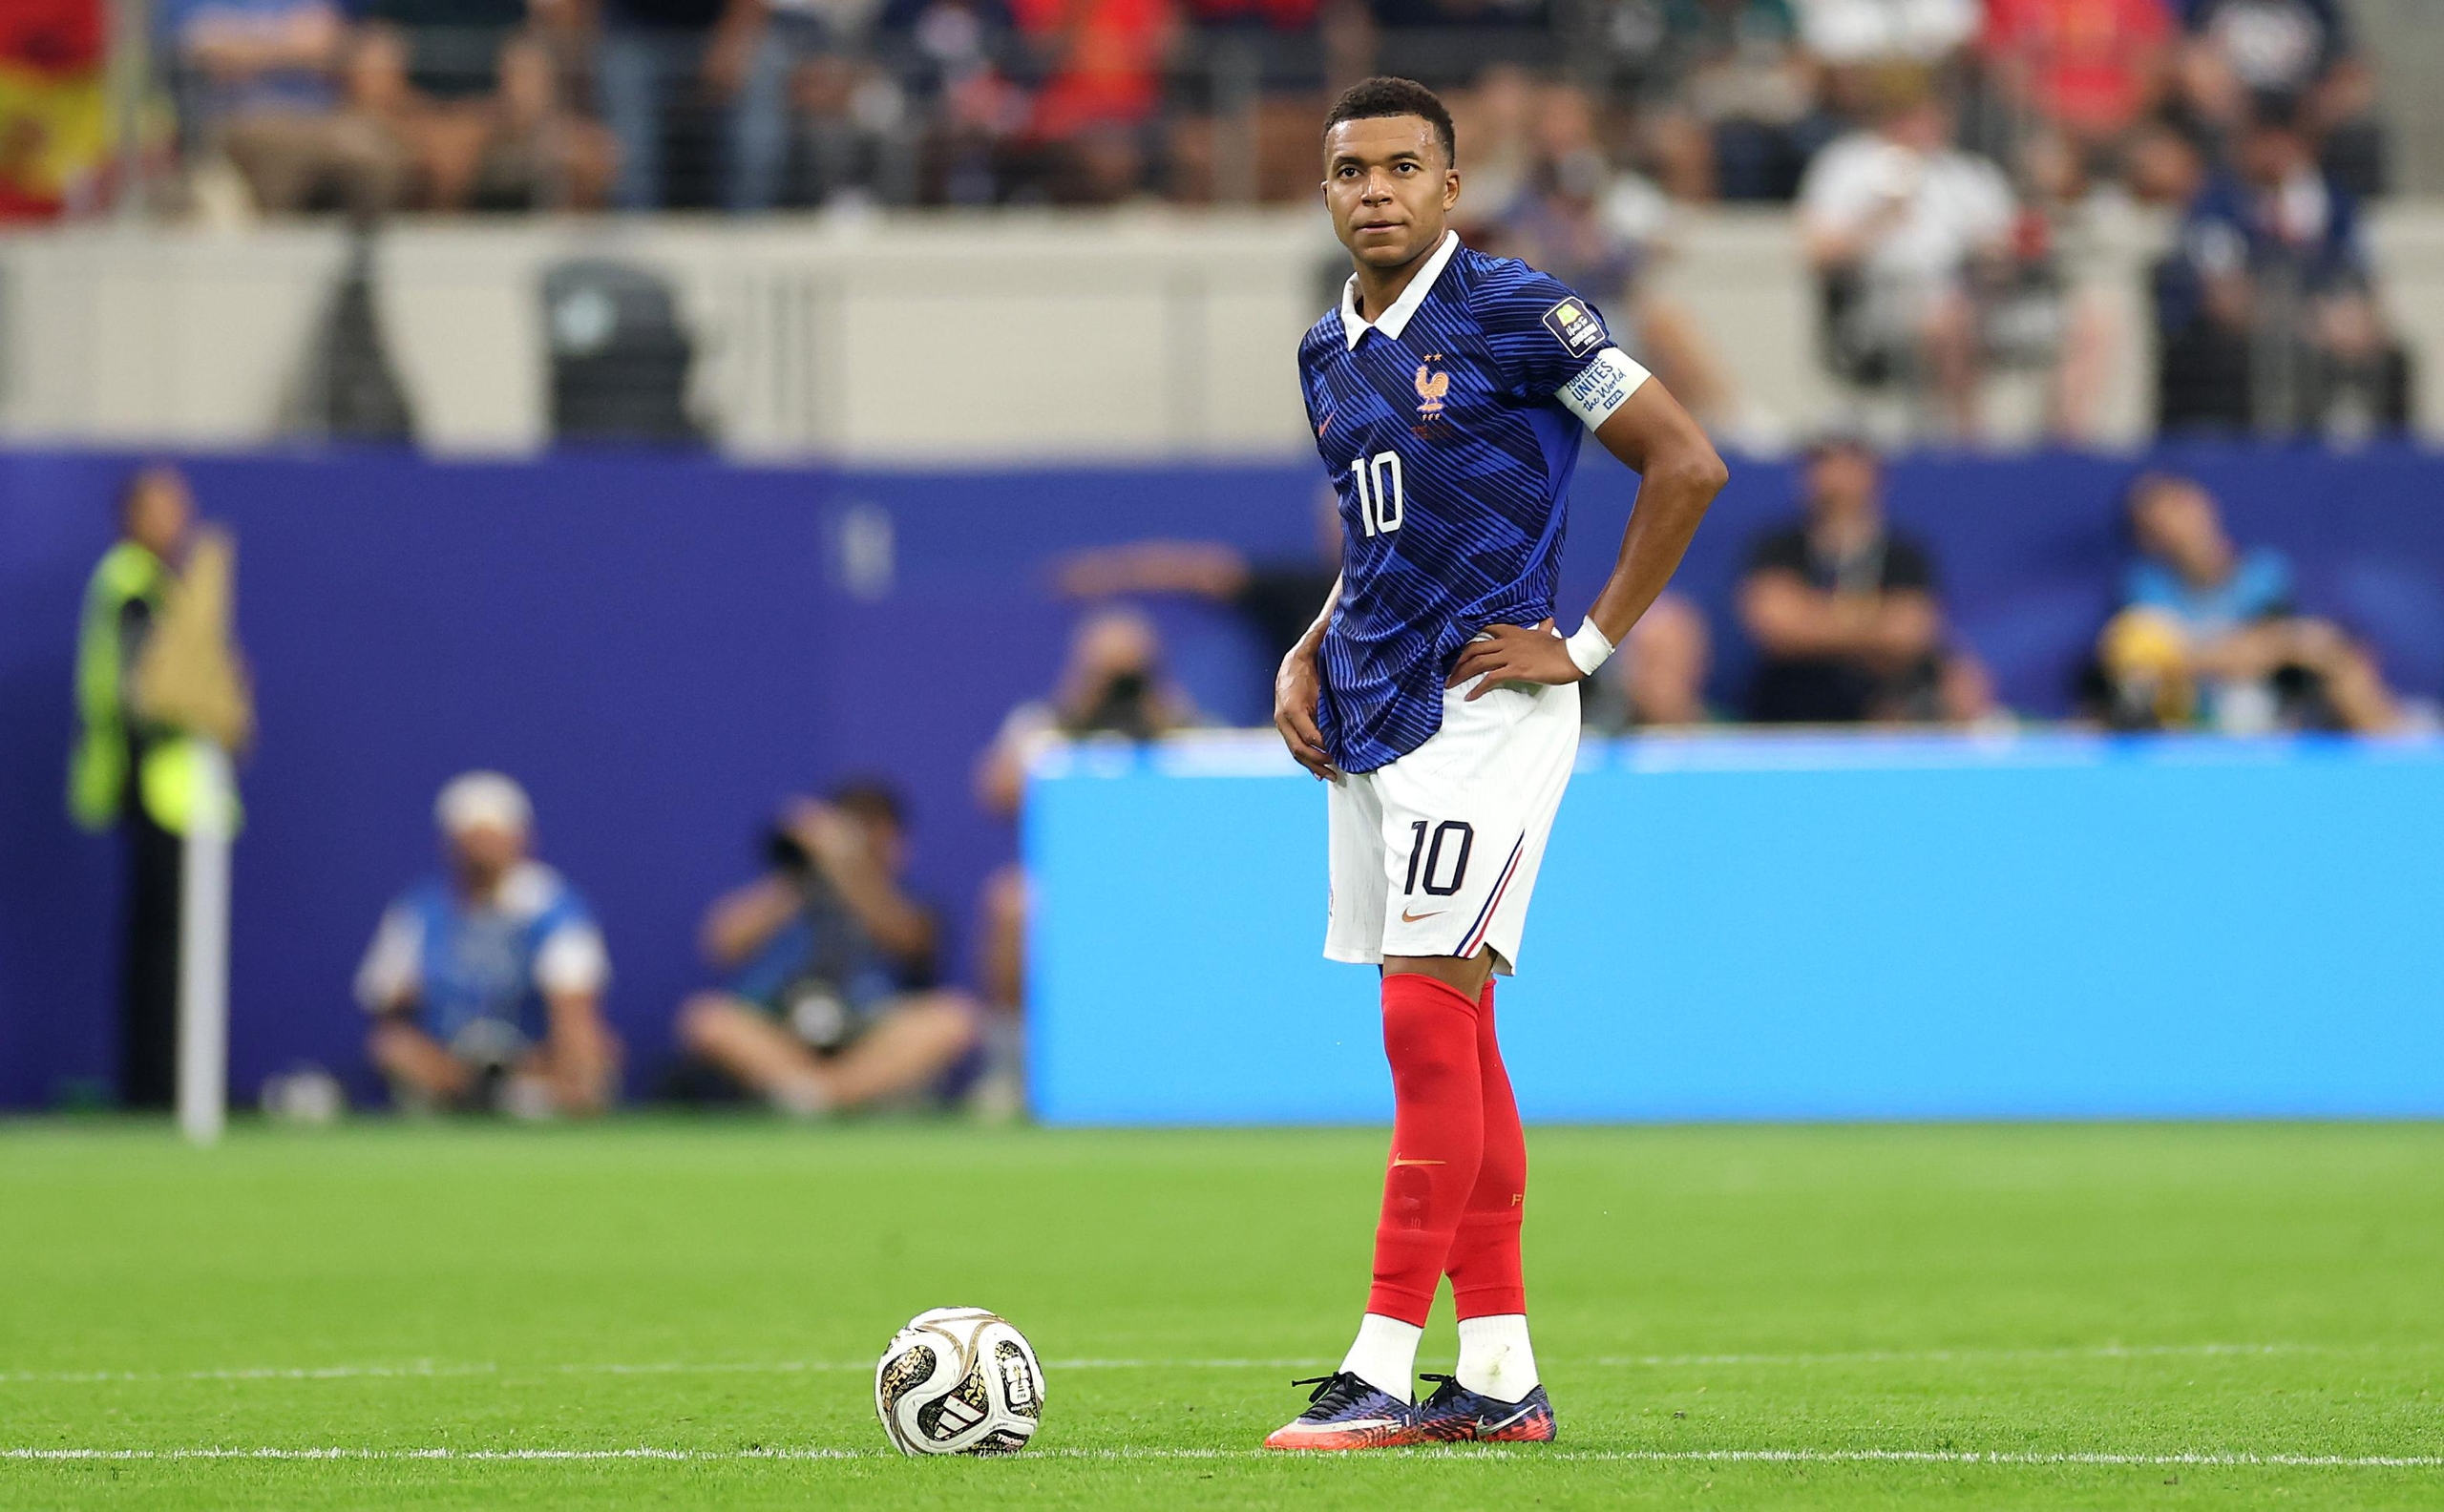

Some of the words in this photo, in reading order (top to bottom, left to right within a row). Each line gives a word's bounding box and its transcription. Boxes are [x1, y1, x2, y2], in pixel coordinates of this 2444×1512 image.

[1571, 361, 1613, 401] UNITES
[1583, 397, 1599, 411] the
[1595, 368, 1627, 398] World
[1352, 451, 1402, 536] 10
[1404, 820, 1474, 895] 10
